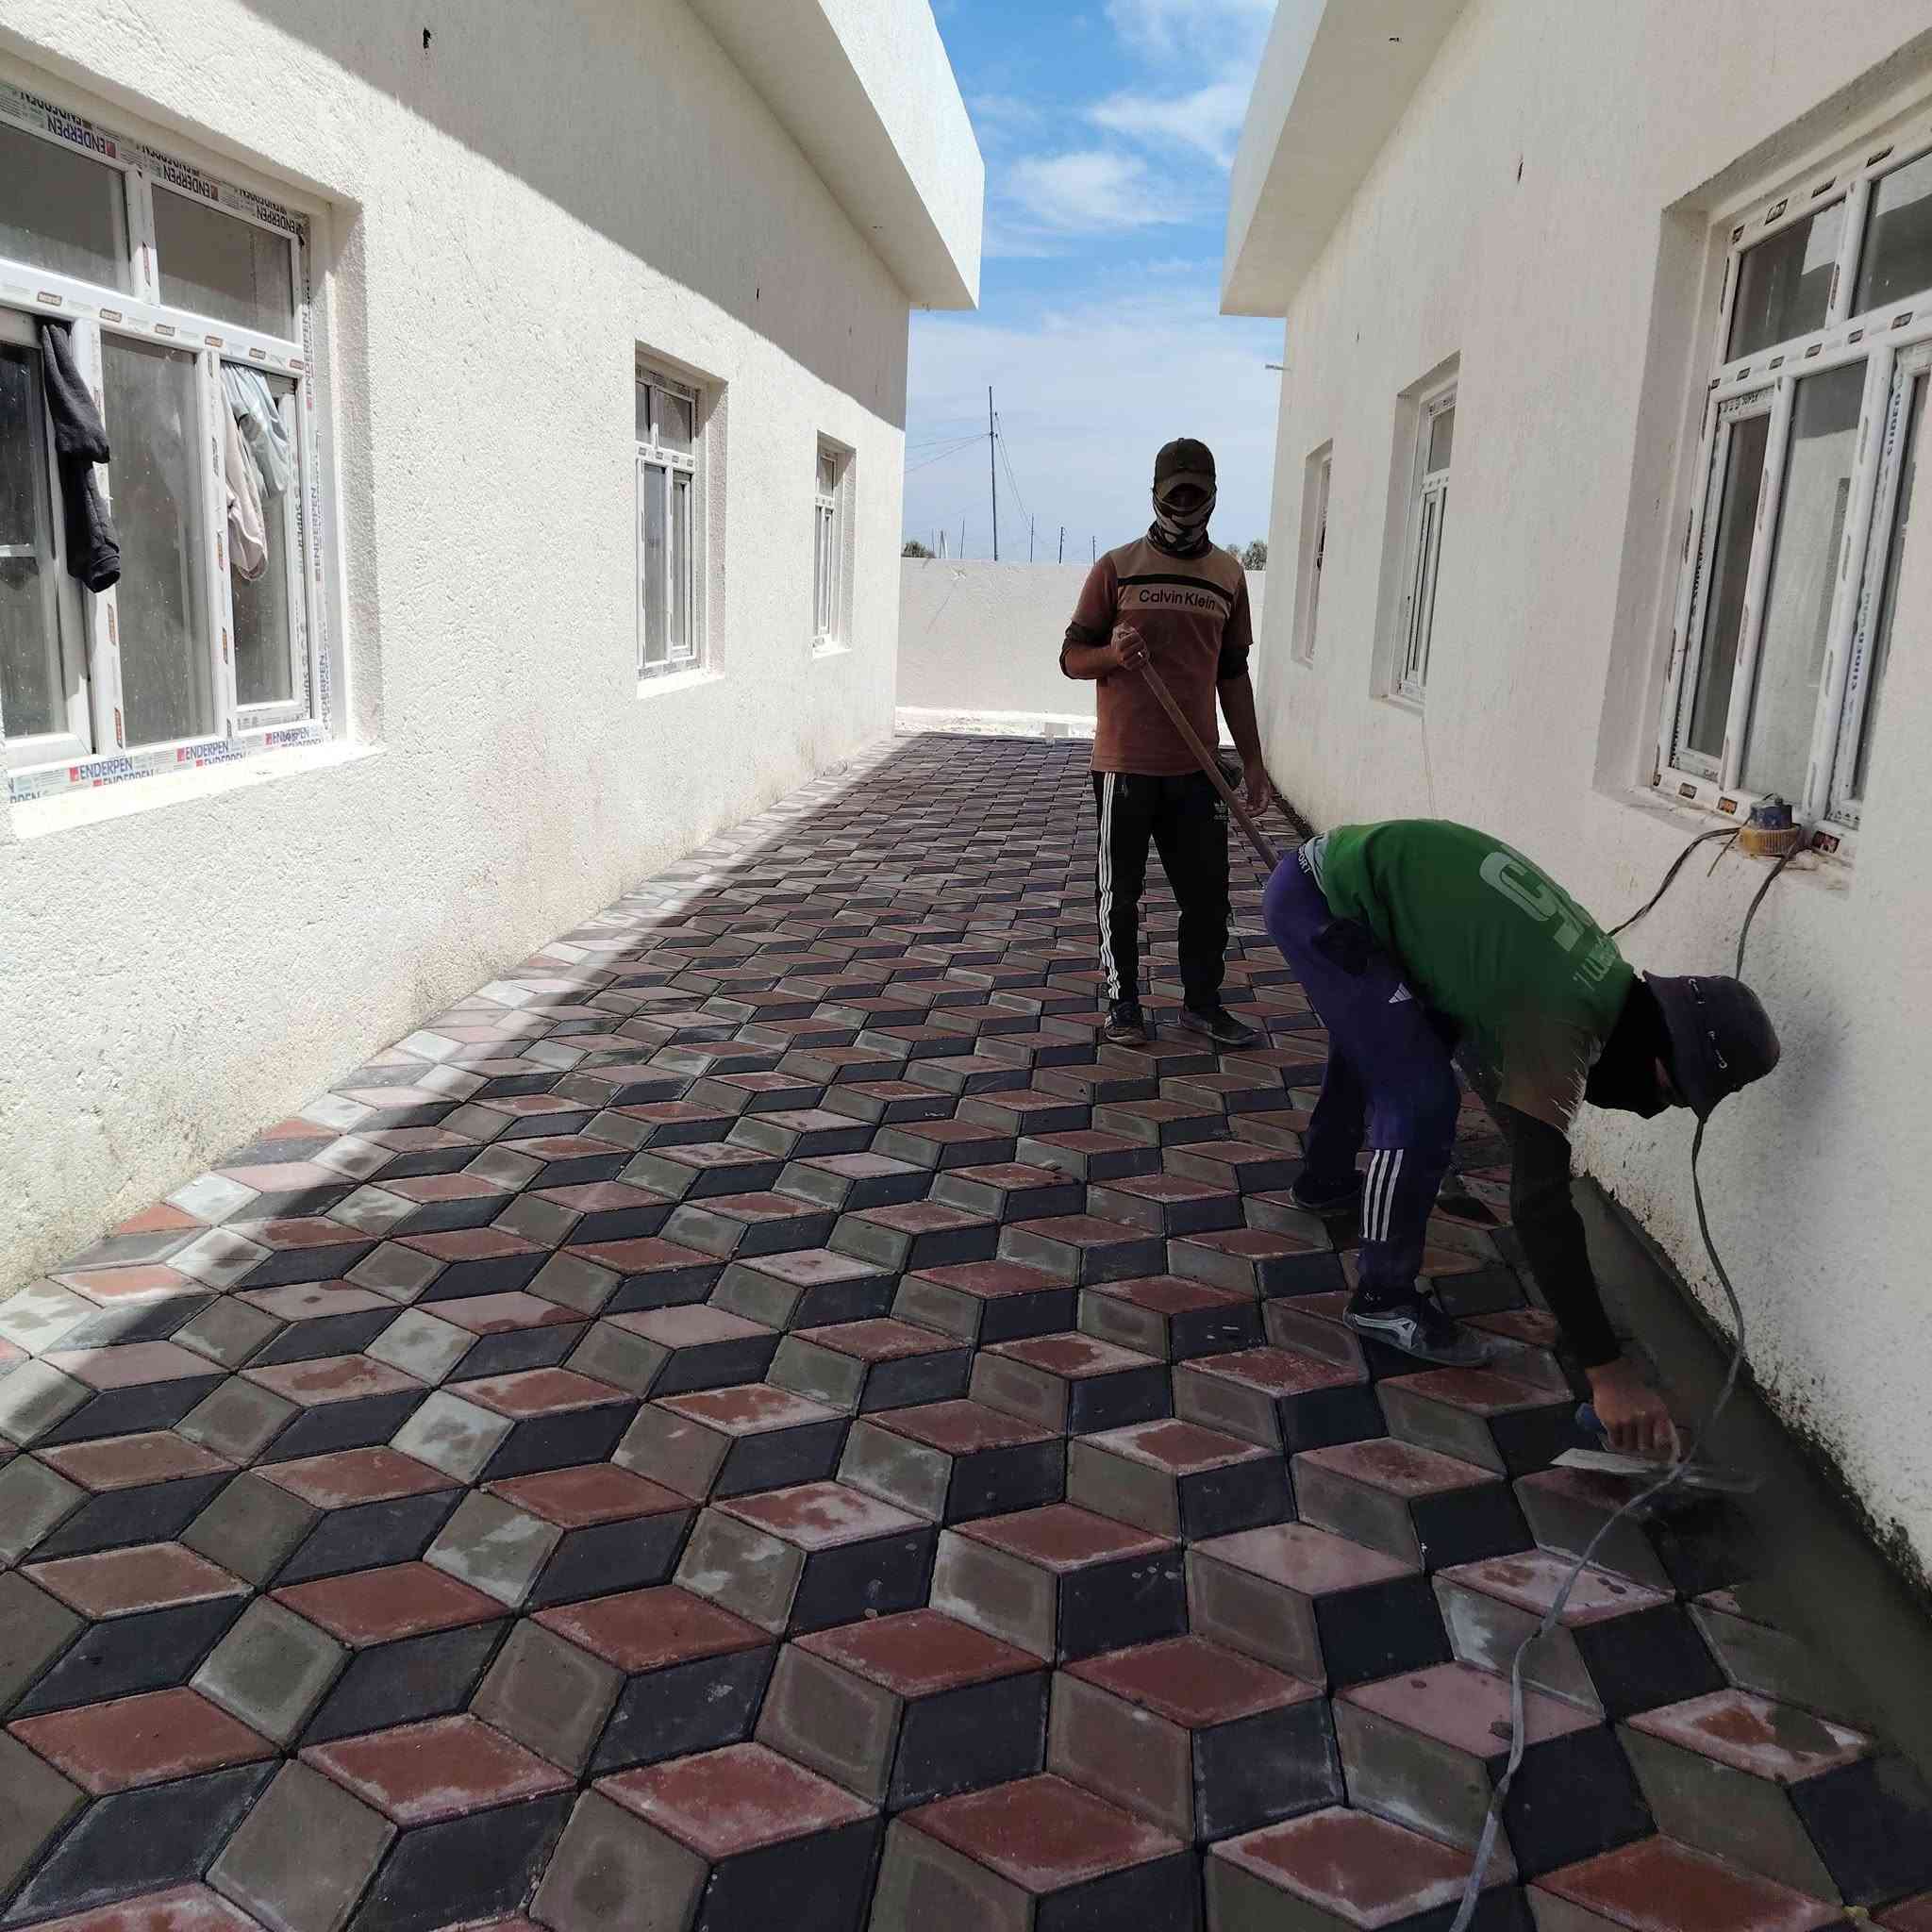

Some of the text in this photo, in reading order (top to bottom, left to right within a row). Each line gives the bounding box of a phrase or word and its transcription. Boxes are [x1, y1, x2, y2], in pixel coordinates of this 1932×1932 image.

[47, 114, 106, 155] ENDERPEN
[163, 164, 210, 198] ENDERPEN
[1139, 588, 1216, 610] Calvin Klein
[185, 740, 229, 760] ENDERPEN
[80, 756, 134, 780] ENDERPEN
